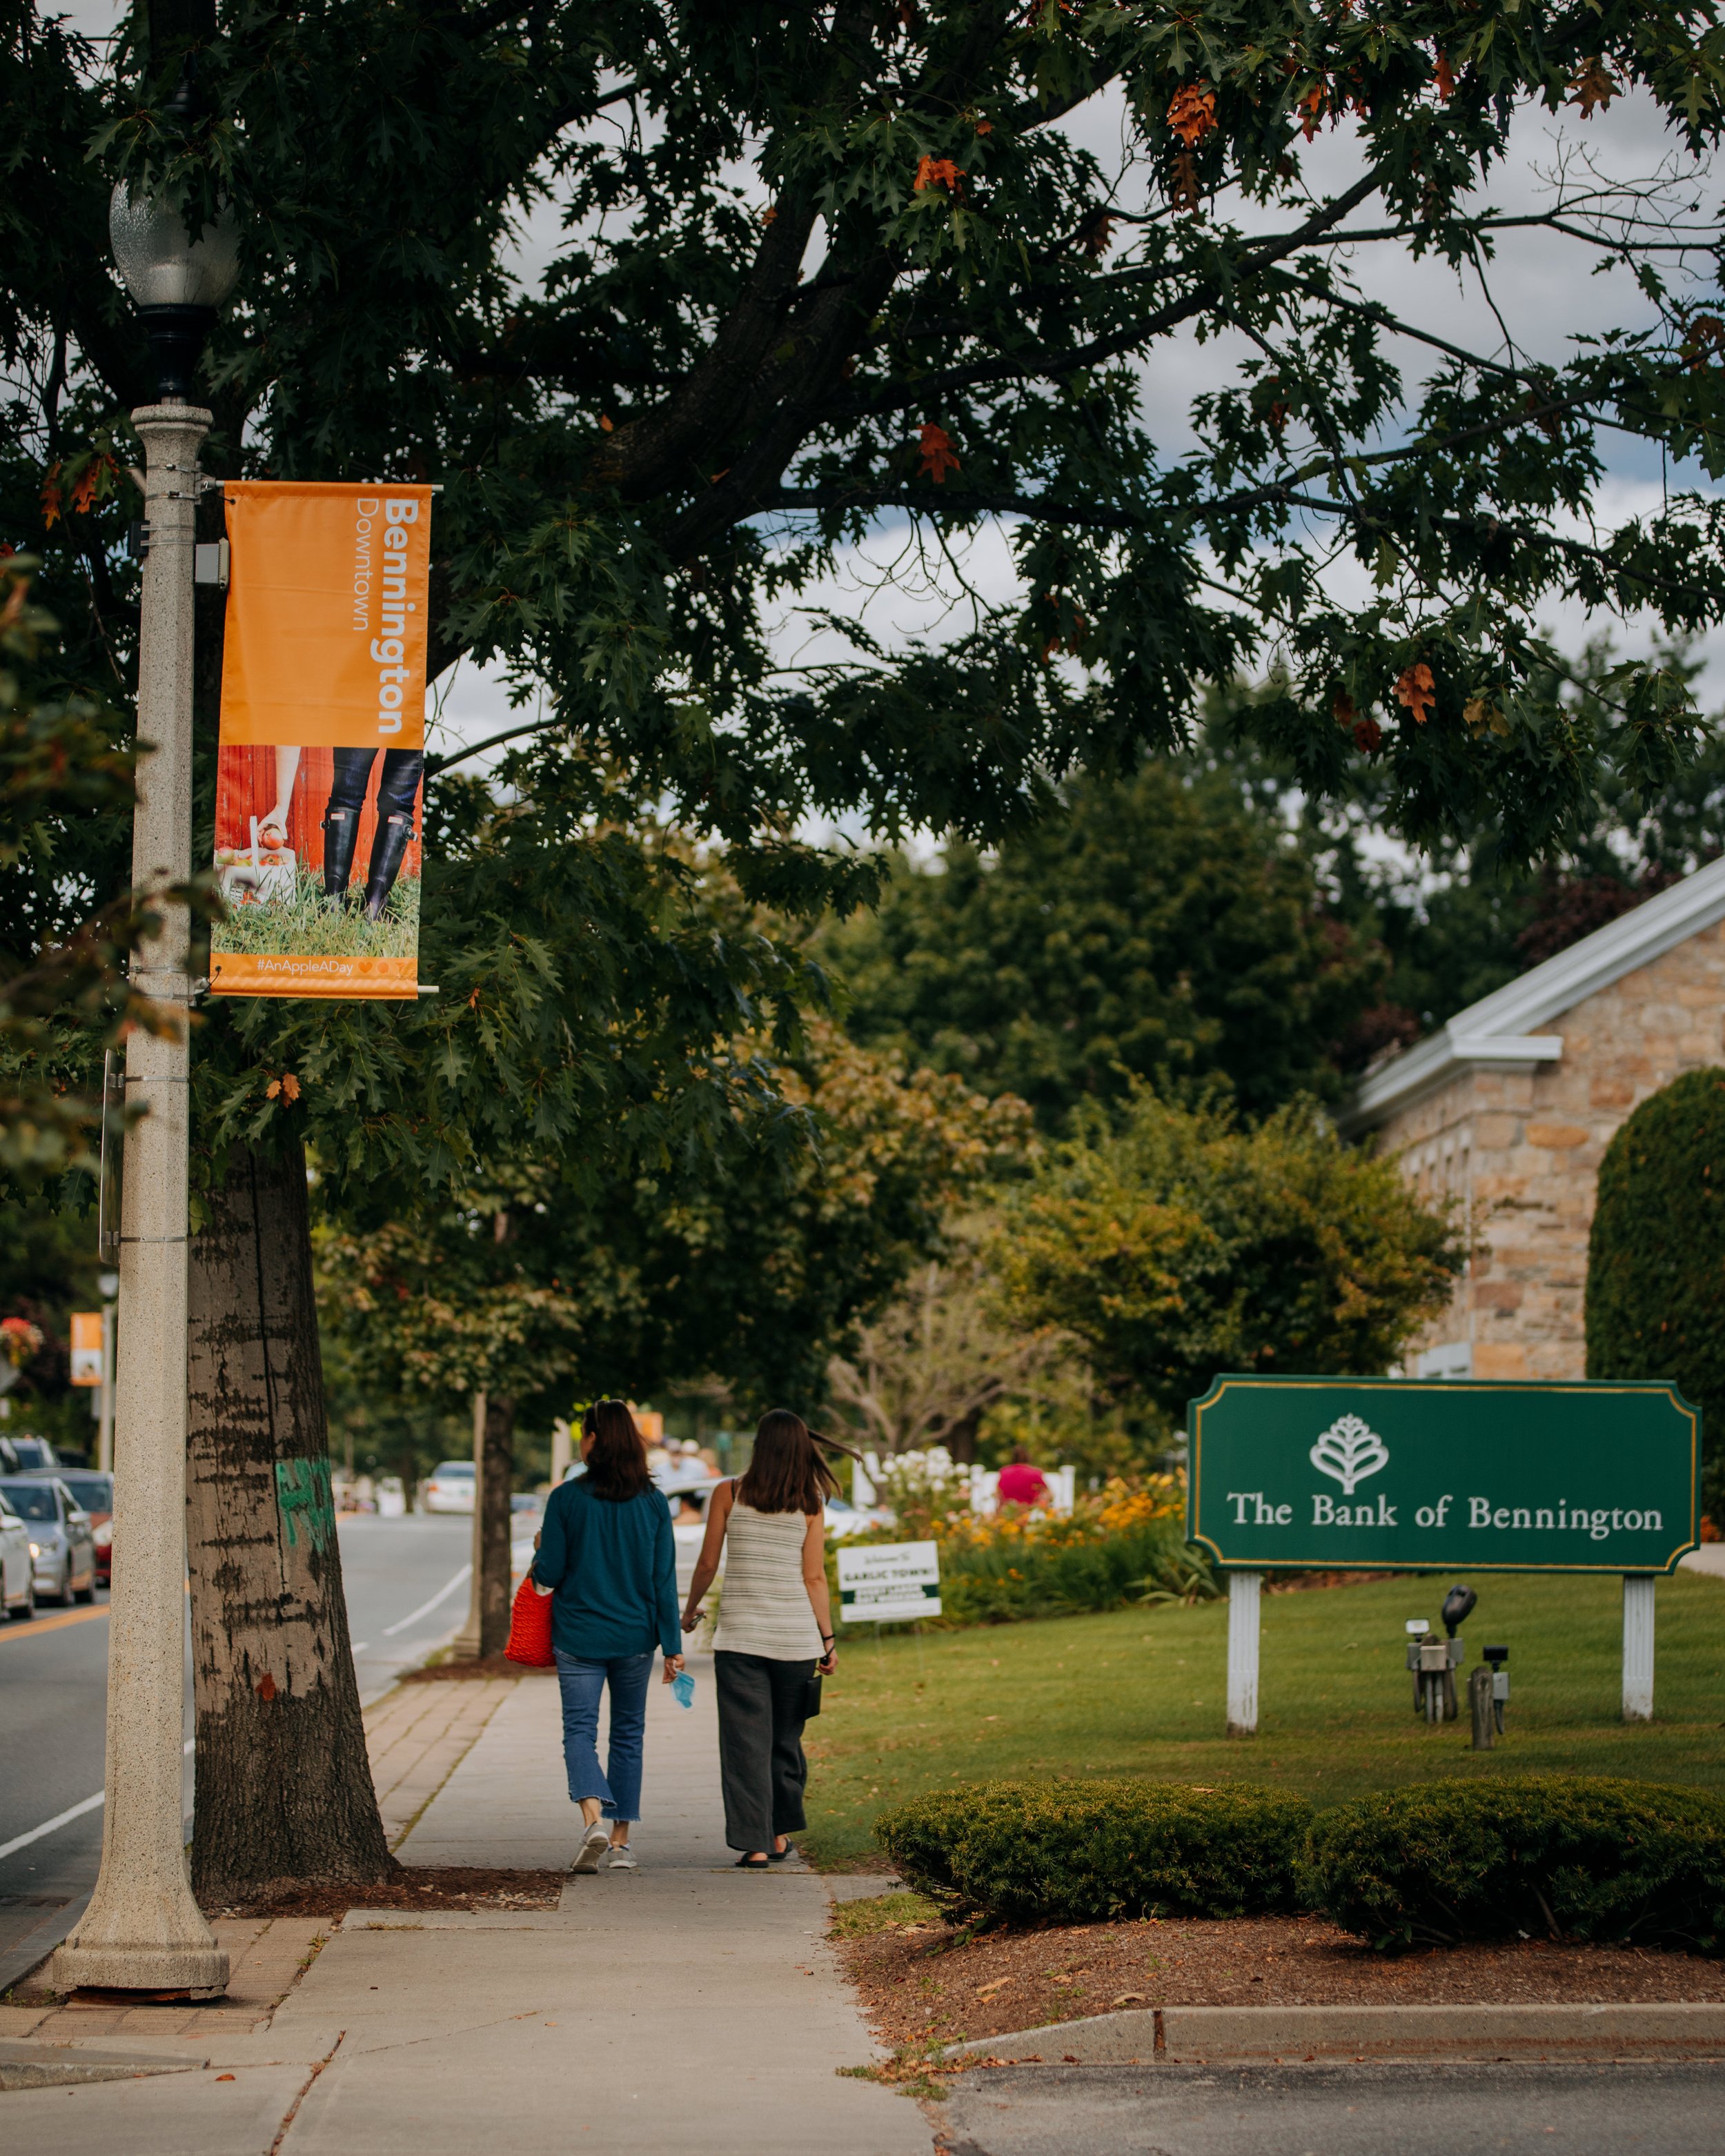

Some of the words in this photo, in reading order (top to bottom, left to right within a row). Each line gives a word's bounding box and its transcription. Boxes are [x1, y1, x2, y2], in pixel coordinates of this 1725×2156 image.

[353, 498, 379, 631] Downtown
[370, 498, 419, 733] Bennington
[257, 958, 353, 976] #AnAppleADay
[1226, 1492, 1292, 1525] The
[1312, 1494, 1399, 1527] Bank
[1415, 1494, 1453, 1527] of
[1468, 1497, 1664, 1541] Bennington
